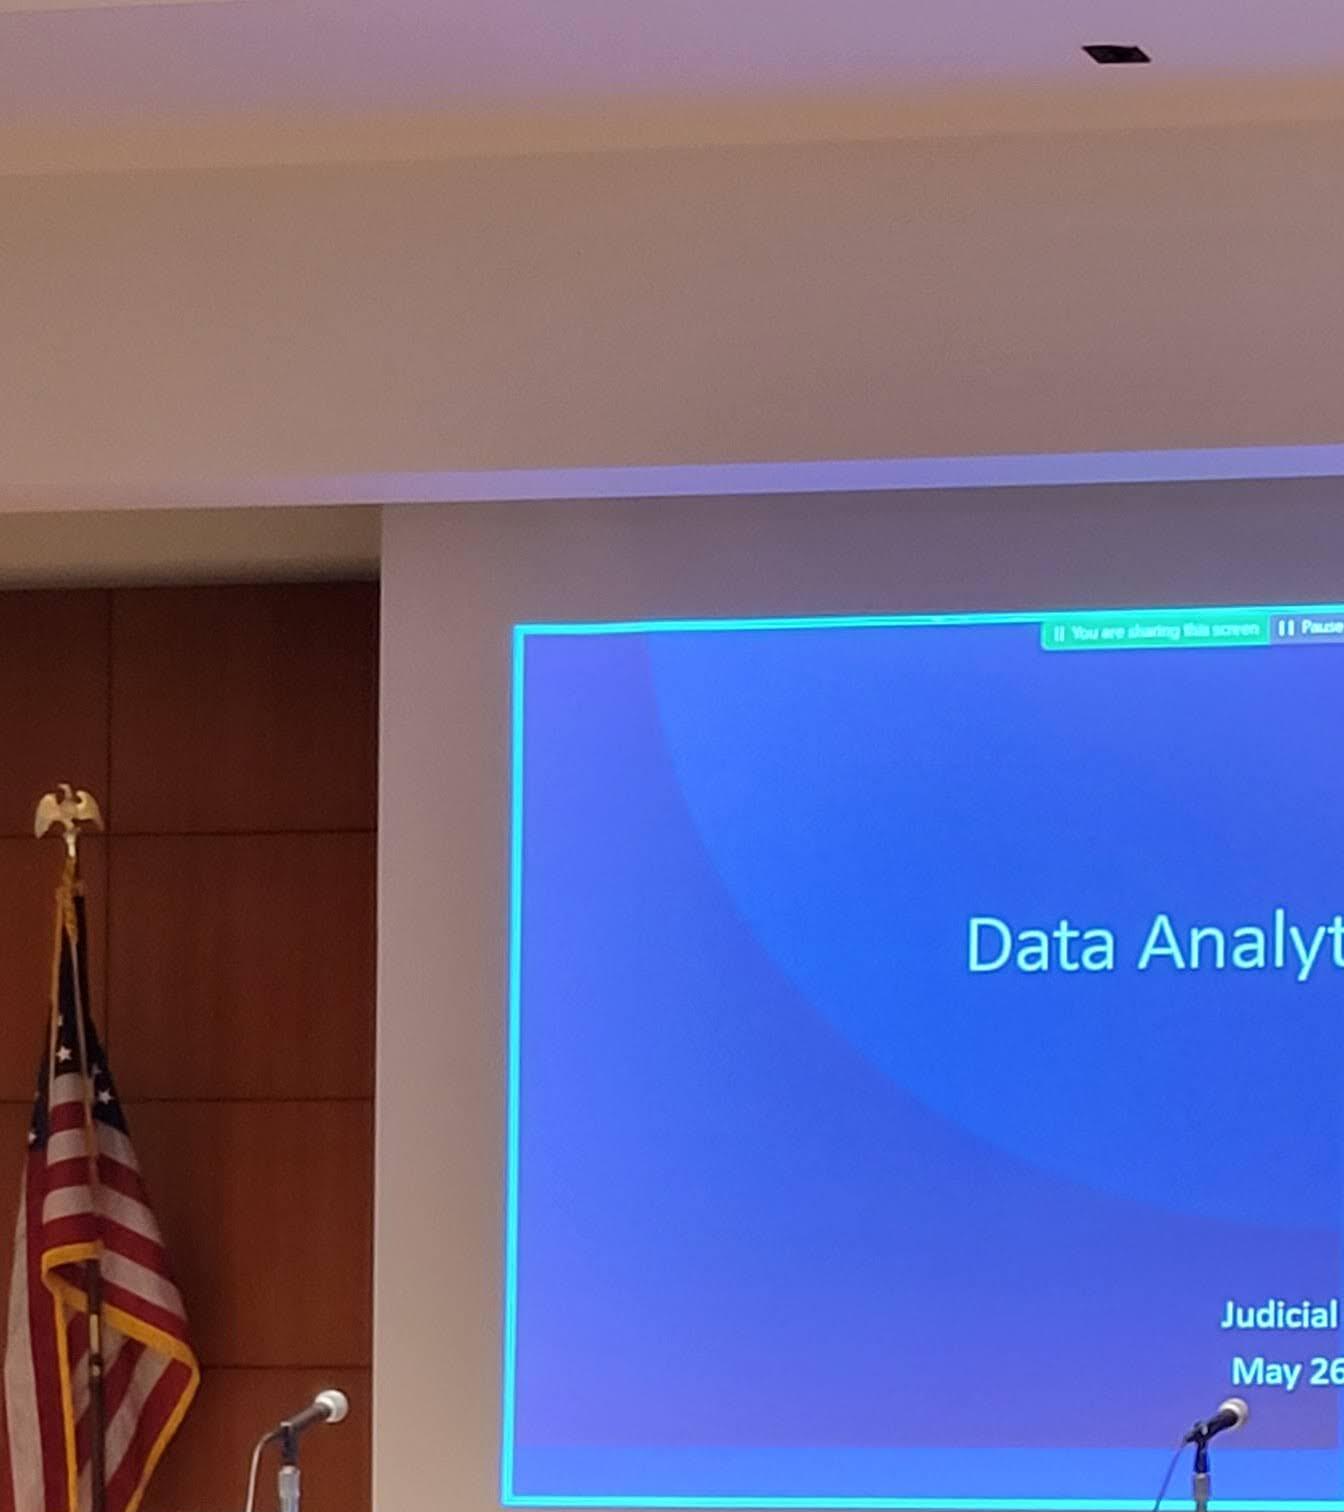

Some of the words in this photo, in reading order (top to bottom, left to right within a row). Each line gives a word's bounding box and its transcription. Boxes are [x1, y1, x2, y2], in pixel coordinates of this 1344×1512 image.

[1302, 619, 1344, 635] Pause
[967, 916, 1115, 973] Data
[1220, 1298, 1338, 1329] Judicial
[1231, 1356, 1303, 1391] May
